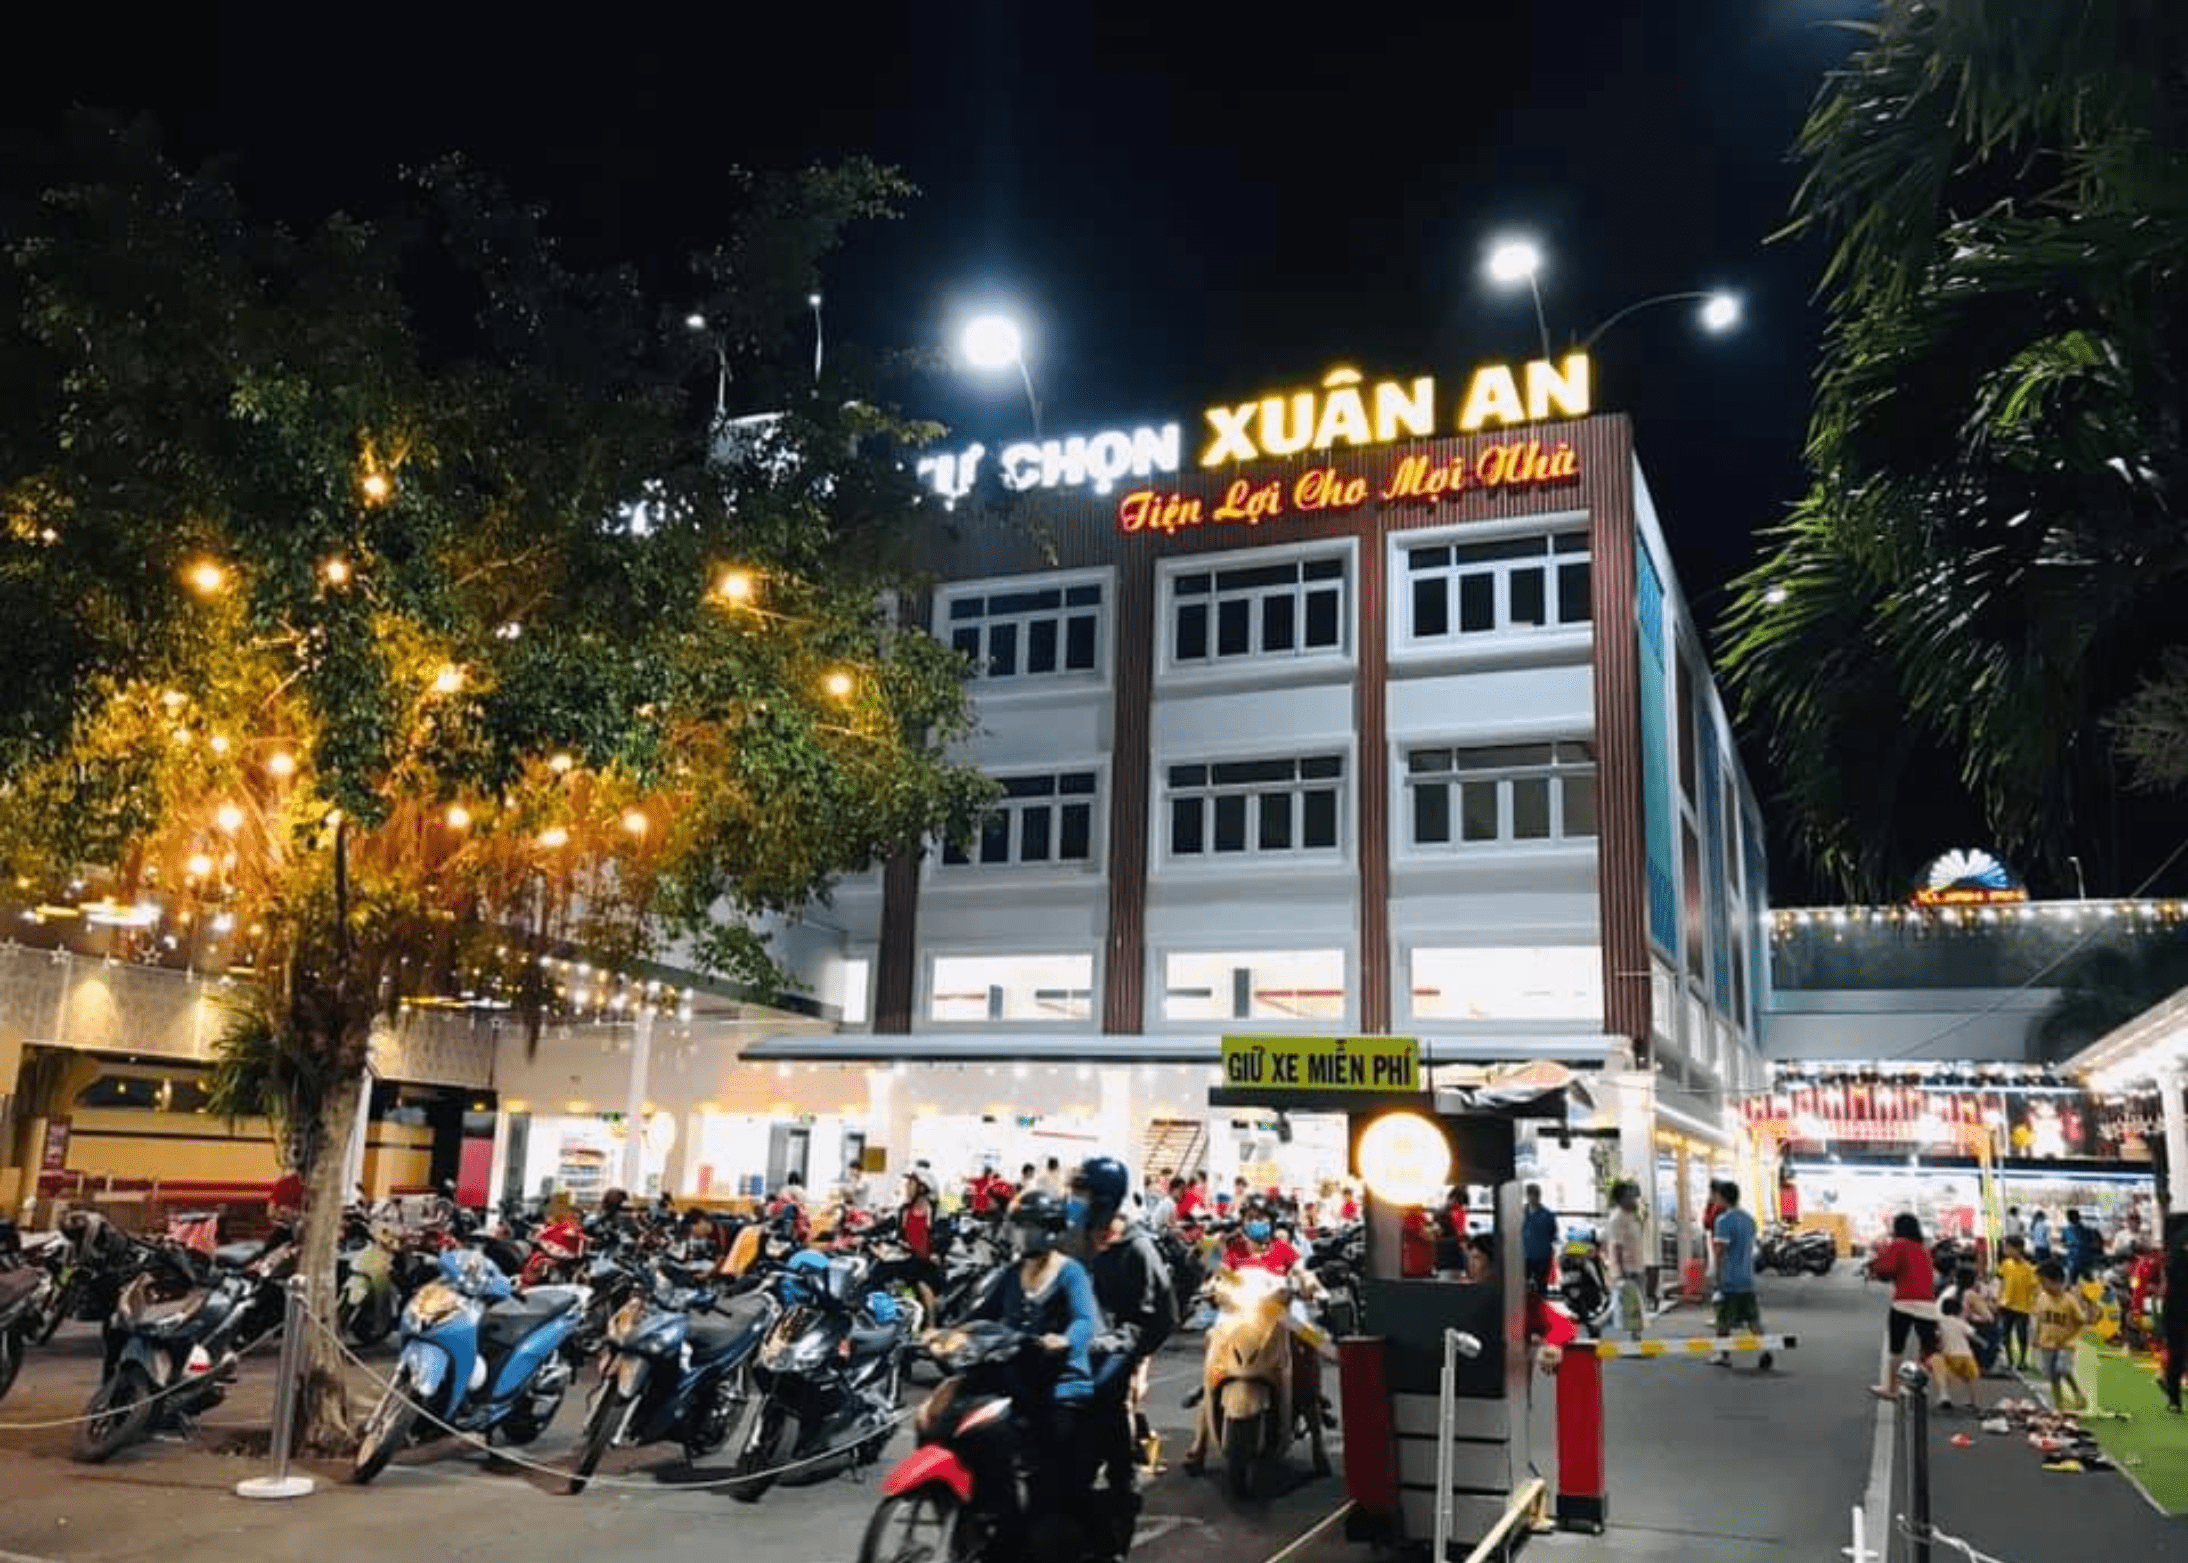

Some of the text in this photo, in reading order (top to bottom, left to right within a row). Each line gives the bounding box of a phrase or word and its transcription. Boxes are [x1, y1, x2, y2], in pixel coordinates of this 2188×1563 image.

[1000, 422, 1181, 495] CHỌN
[1201, 367, 1436, 468] XUÂN
[1458, 353, 1591, 431] AN
[1120, 439, 1580, 534] Tiện Lợi Cho Mọi Nhà
[1228, 1039, 1412, 1086] GIỮ XE MIỄN PHÍ
